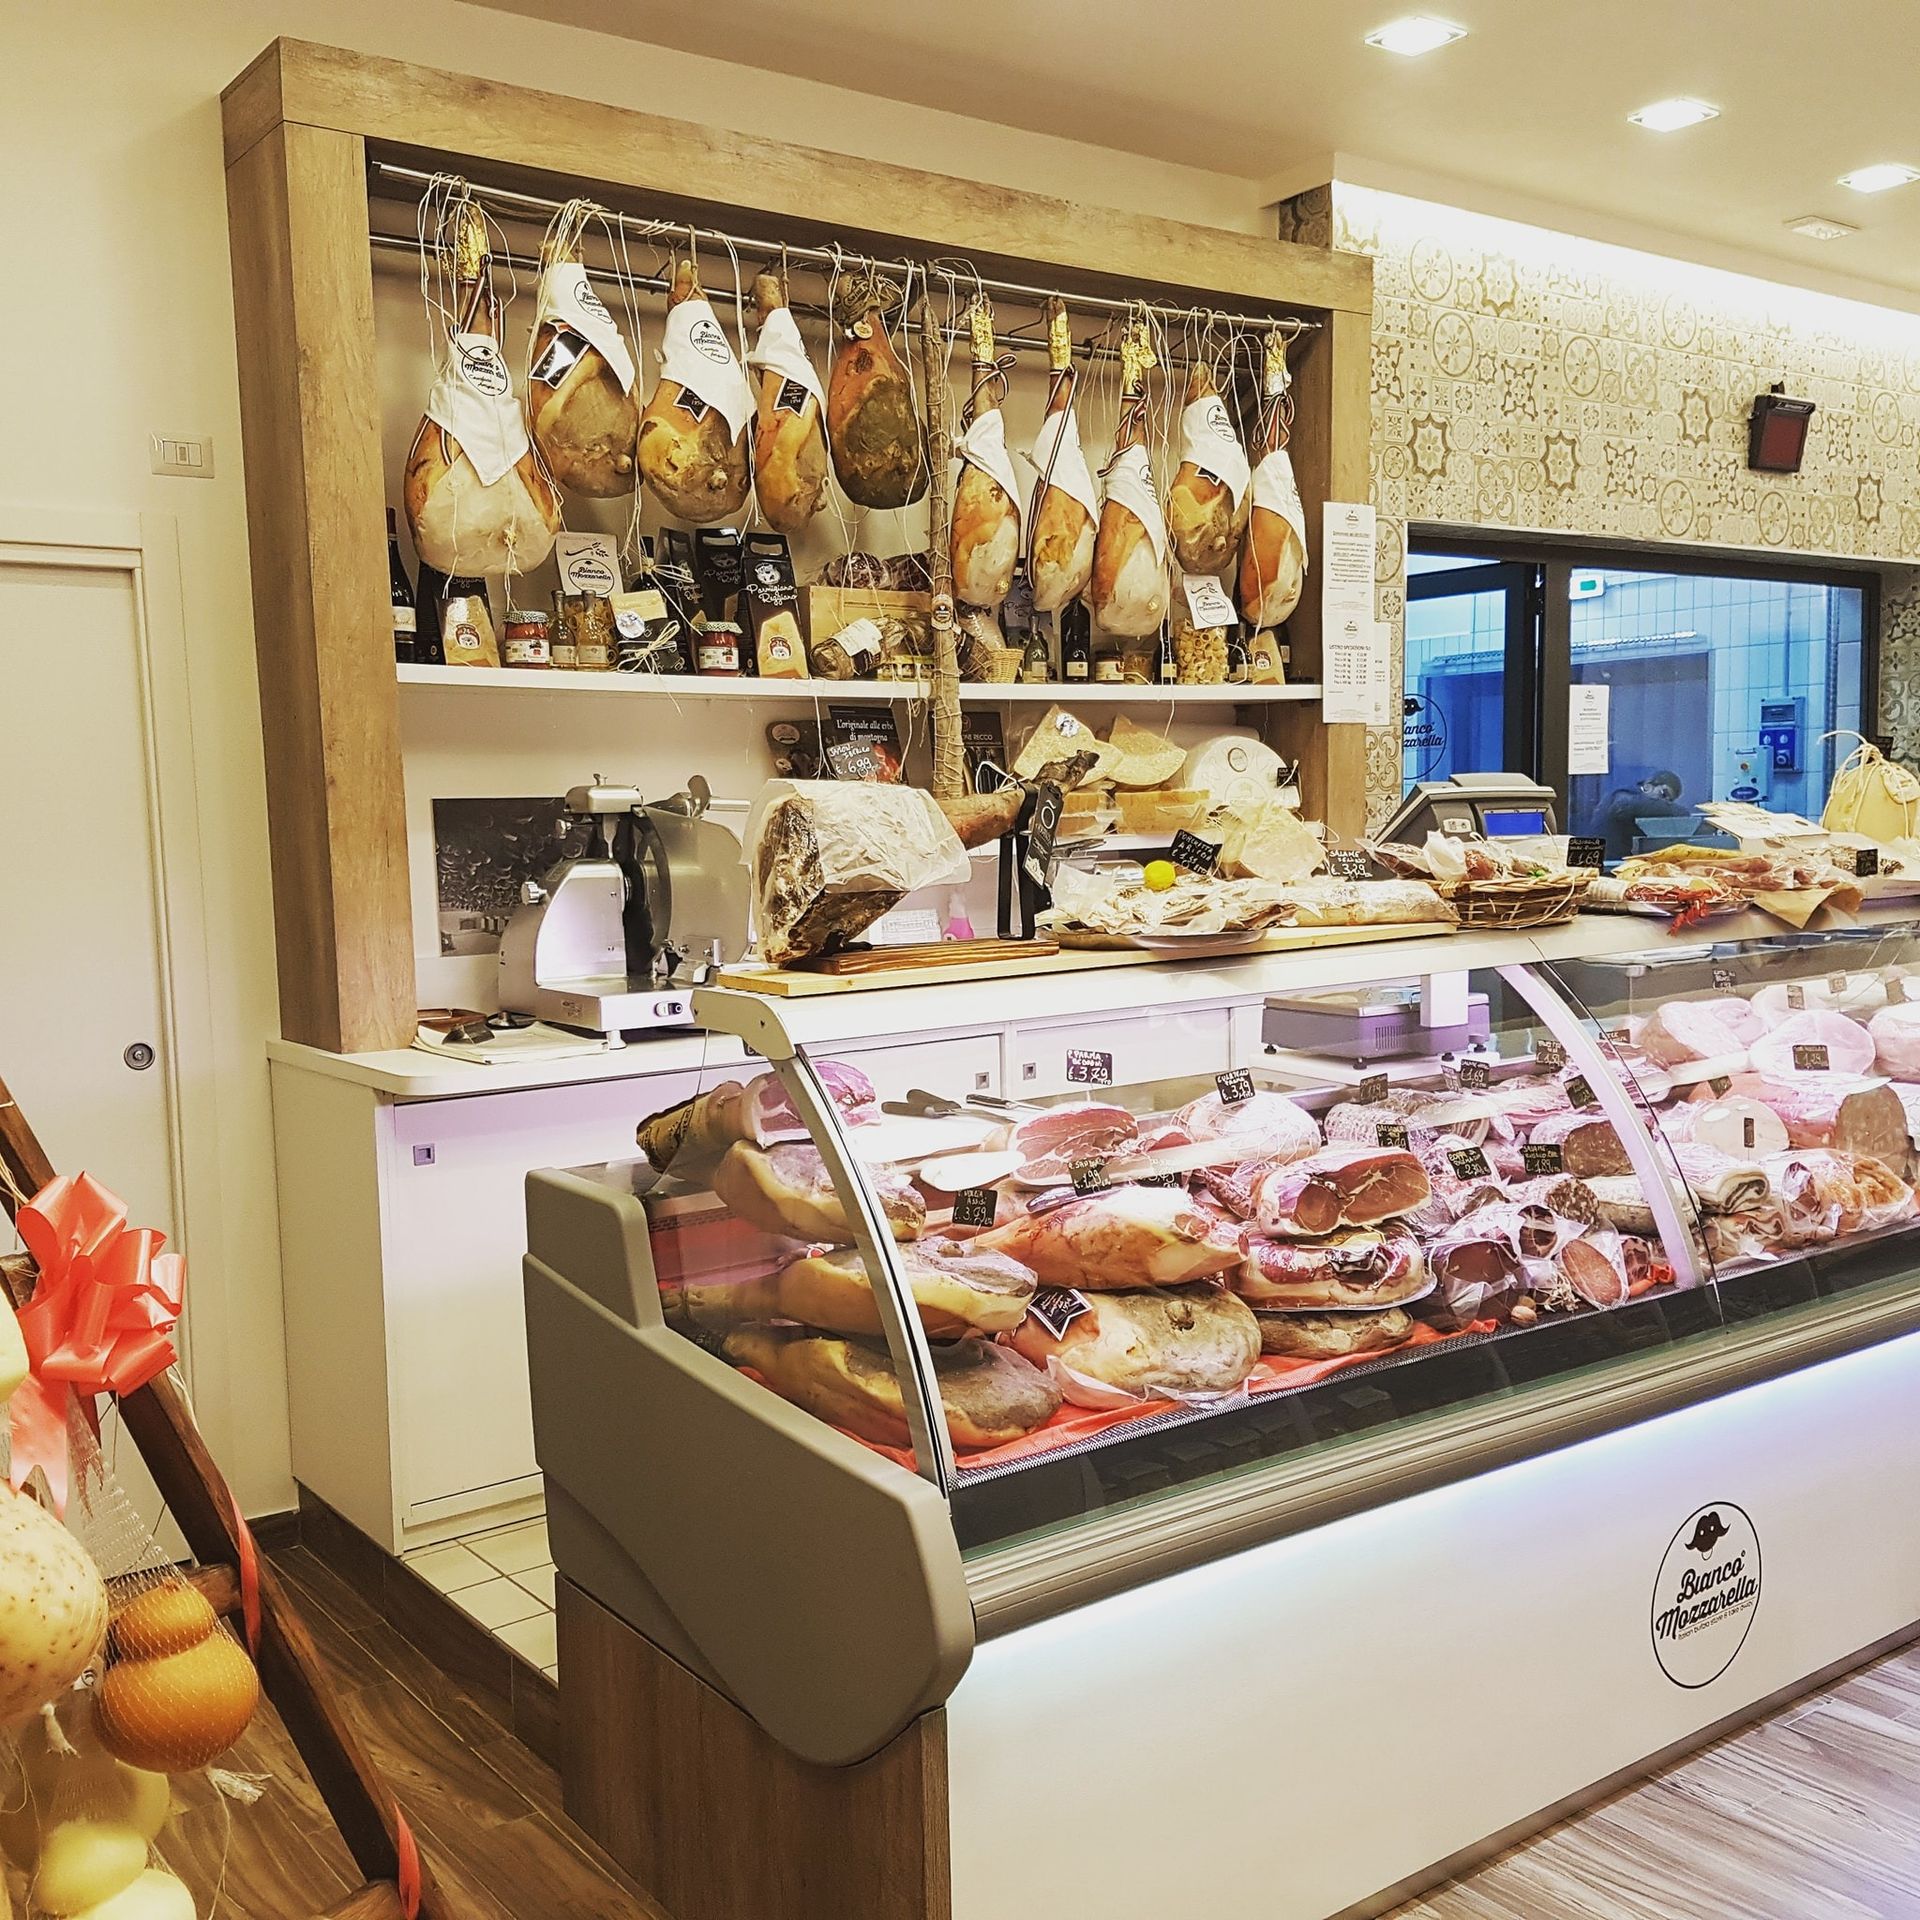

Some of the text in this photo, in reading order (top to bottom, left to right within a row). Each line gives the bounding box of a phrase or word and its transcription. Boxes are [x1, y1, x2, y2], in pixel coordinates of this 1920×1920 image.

[570, 571, 612, 581] Mozzarella
[578, 566, 605, 575] Bianco
[746, 583, 795, 597] Parmigiano
[758, 592, 798, 606] Reggiano
[836, 719, 869, 731] L'originale
[869, 720, 881, 730] alle
[849, 731, 857, 741] di
[1329, 850, 1361, 858] SALAME
[1073, 1050, 1102, 1061] PARMA
[1677, 1556, 1745, 1604] Bianco
[1655, 1575, 1758, 1640] Mozzarella
